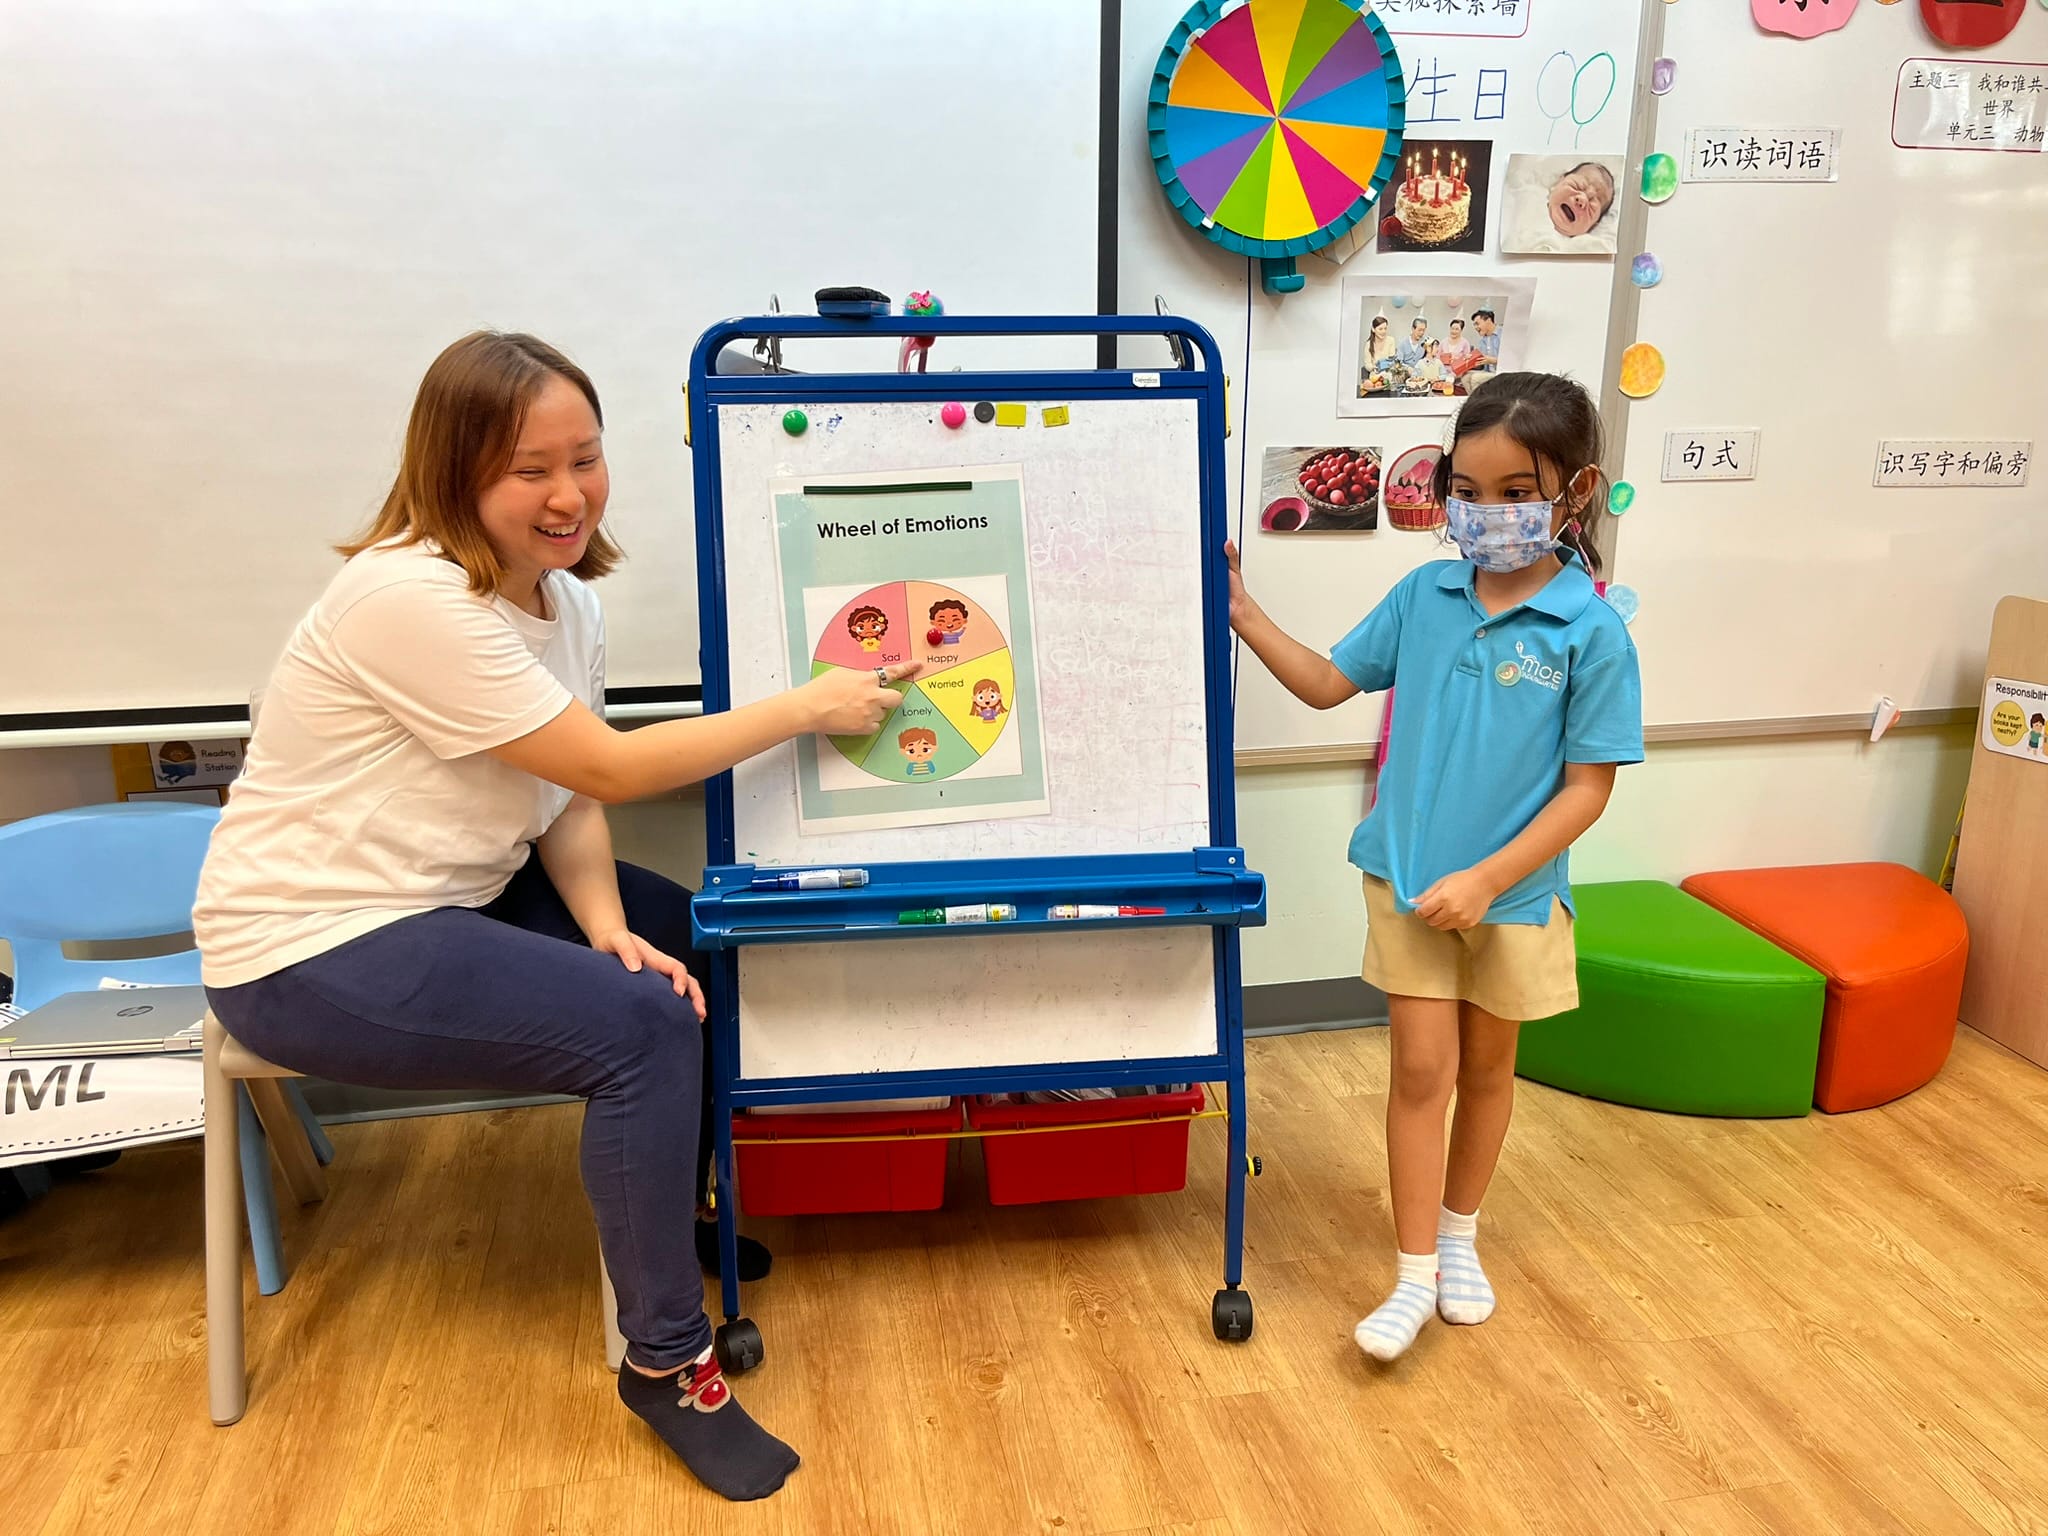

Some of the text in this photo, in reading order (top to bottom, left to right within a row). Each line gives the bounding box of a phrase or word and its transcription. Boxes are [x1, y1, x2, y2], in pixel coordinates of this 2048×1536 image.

[1405, 57, 1507, 123] 生日
[1908, 70, 2048, 93] 主题三 我和谁共
[1983, 99, 2015, 118] 世界
[1946, 121, 2045, 143] 单元三 动物
[1699, 136, 1826, 171] 识读词语
[1683, 439, 1739, 470] 句式
[1880, 450, 2028, 477] 识写字和偏旁
[817, 514, 989, 539] Wheel of Emotions
[881, 652, 901, 662] Sad
[926, 654, 959, 664] Happy
[927, 679, 965, 689] Worried
[902, 706, 933, 717] Lonely
[200, 747, 237, 758] Reading
[204, 762, 238, 772] Station
[5, 1061, 106, 1115] ML
